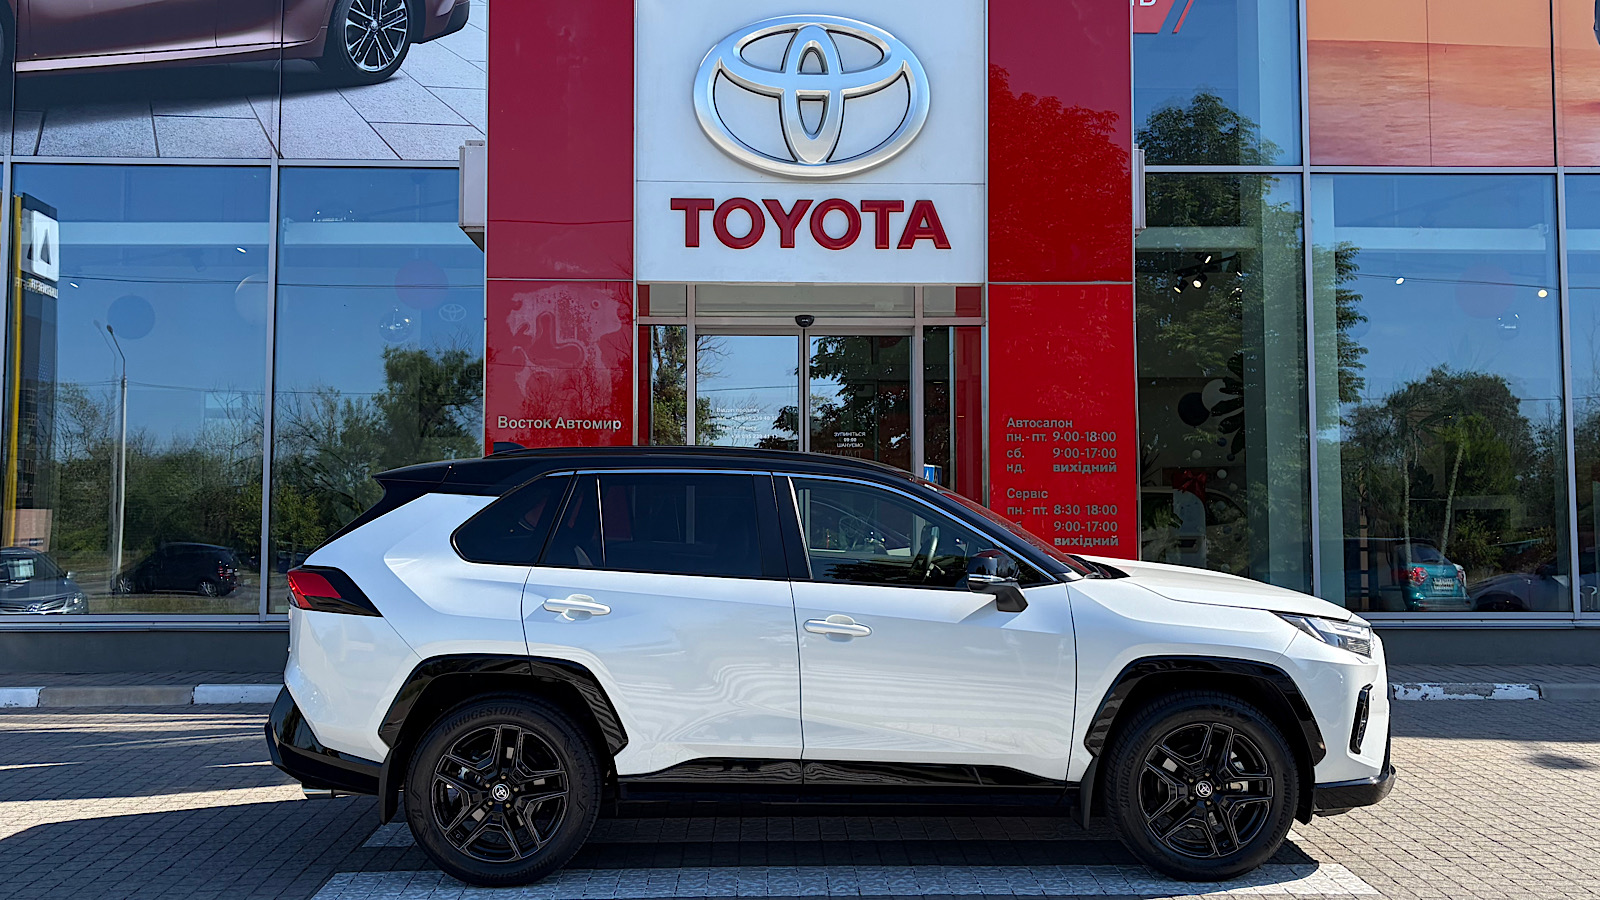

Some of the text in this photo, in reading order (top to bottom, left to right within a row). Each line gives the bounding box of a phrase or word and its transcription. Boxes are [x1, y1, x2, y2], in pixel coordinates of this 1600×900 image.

[670, 197, 951, 250] TOYOTA
[497, 416, 622, 433] Восток Автомир
[1006, 417, 1073, 428] Автосалон
[1052, 431, 1117, 442] 9:00-18:00
[1006, 448, 1117, 459] сб. 9:00-17:00
[1006, 461, 1118, 474] нд. вихідний
[1006, 488, 1049, 501] Сервіс
[1053, 521, 1118, 532] 9:00-17:00
[1054, 535, 1119, 547] вихідний
[442, 706, 524, 737] BRIDGESTONE
